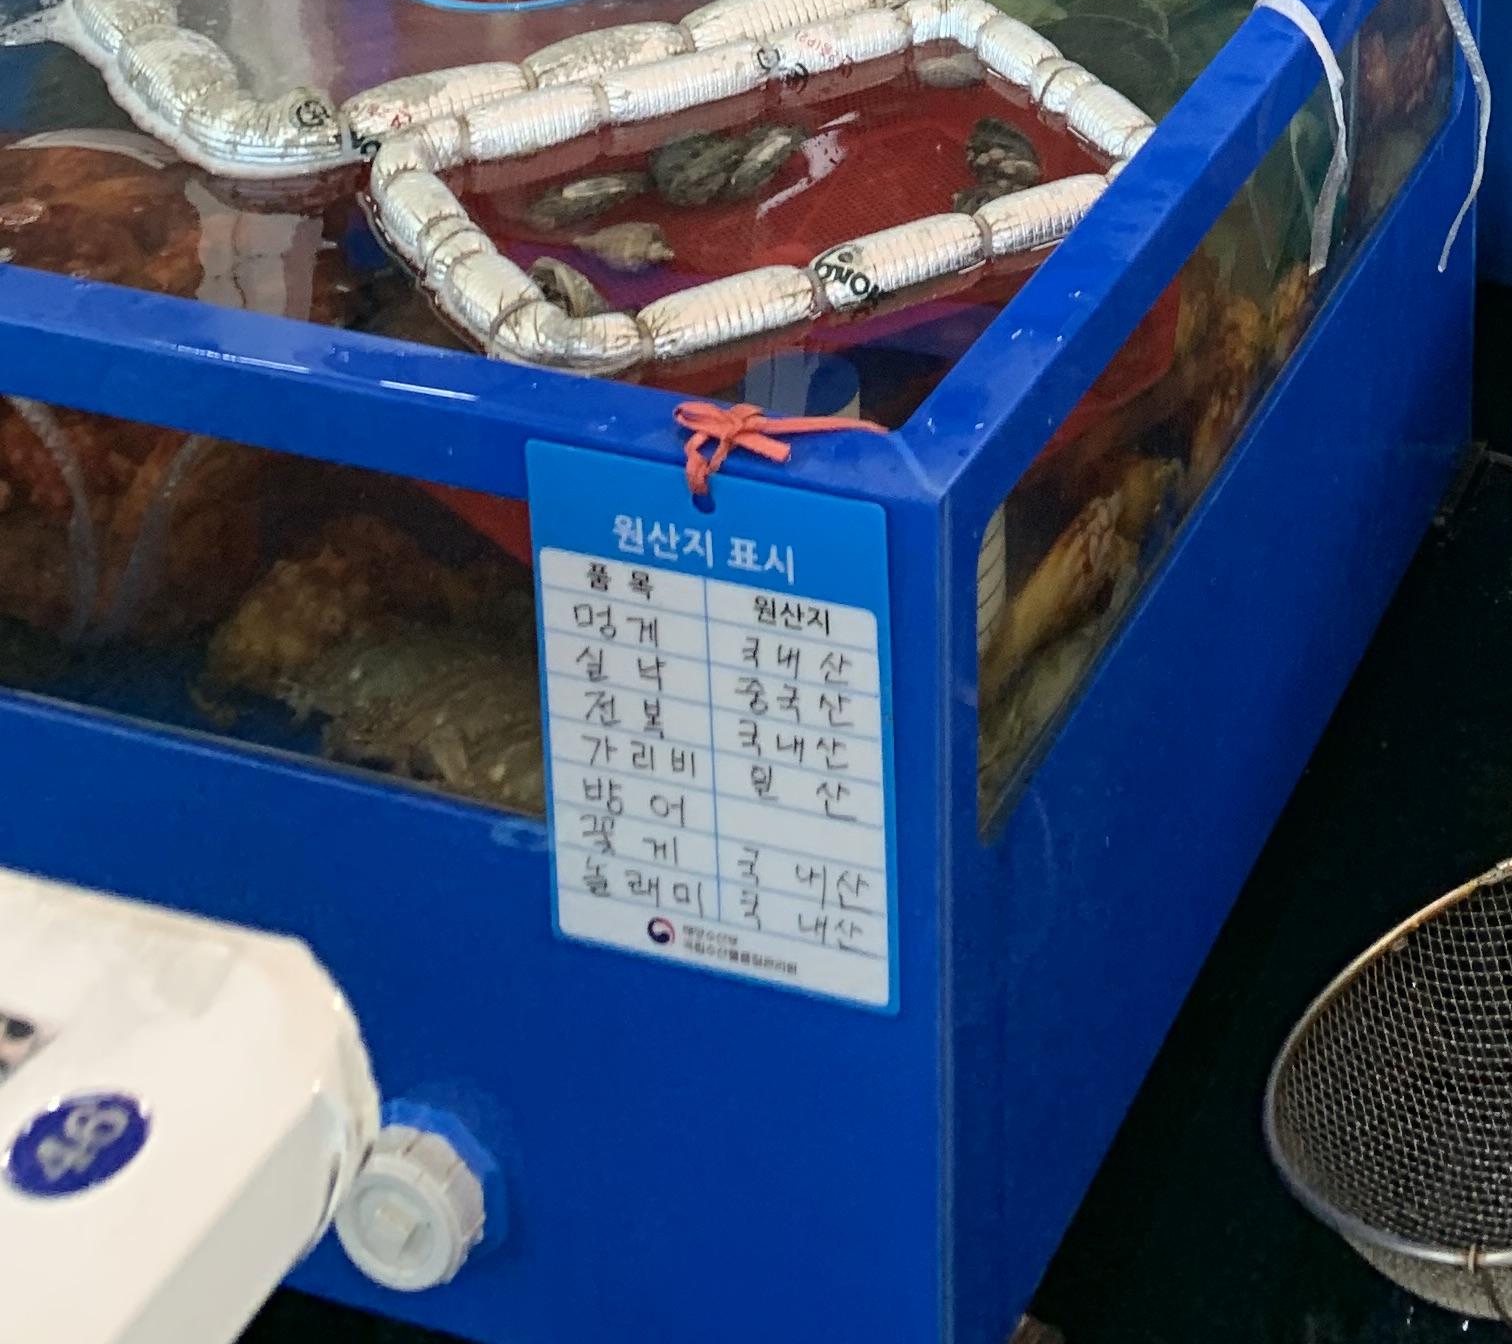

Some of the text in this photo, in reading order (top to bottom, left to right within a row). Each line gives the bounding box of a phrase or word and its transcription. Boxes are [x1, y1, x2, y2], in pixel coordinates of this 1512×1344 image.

[612, 514, 795, 586] 원산지 표시
[573, 604, 659, 648] 멍게
[754, 595, 830, 636] 원산지
[581, 735, 696, 778] 가리비
